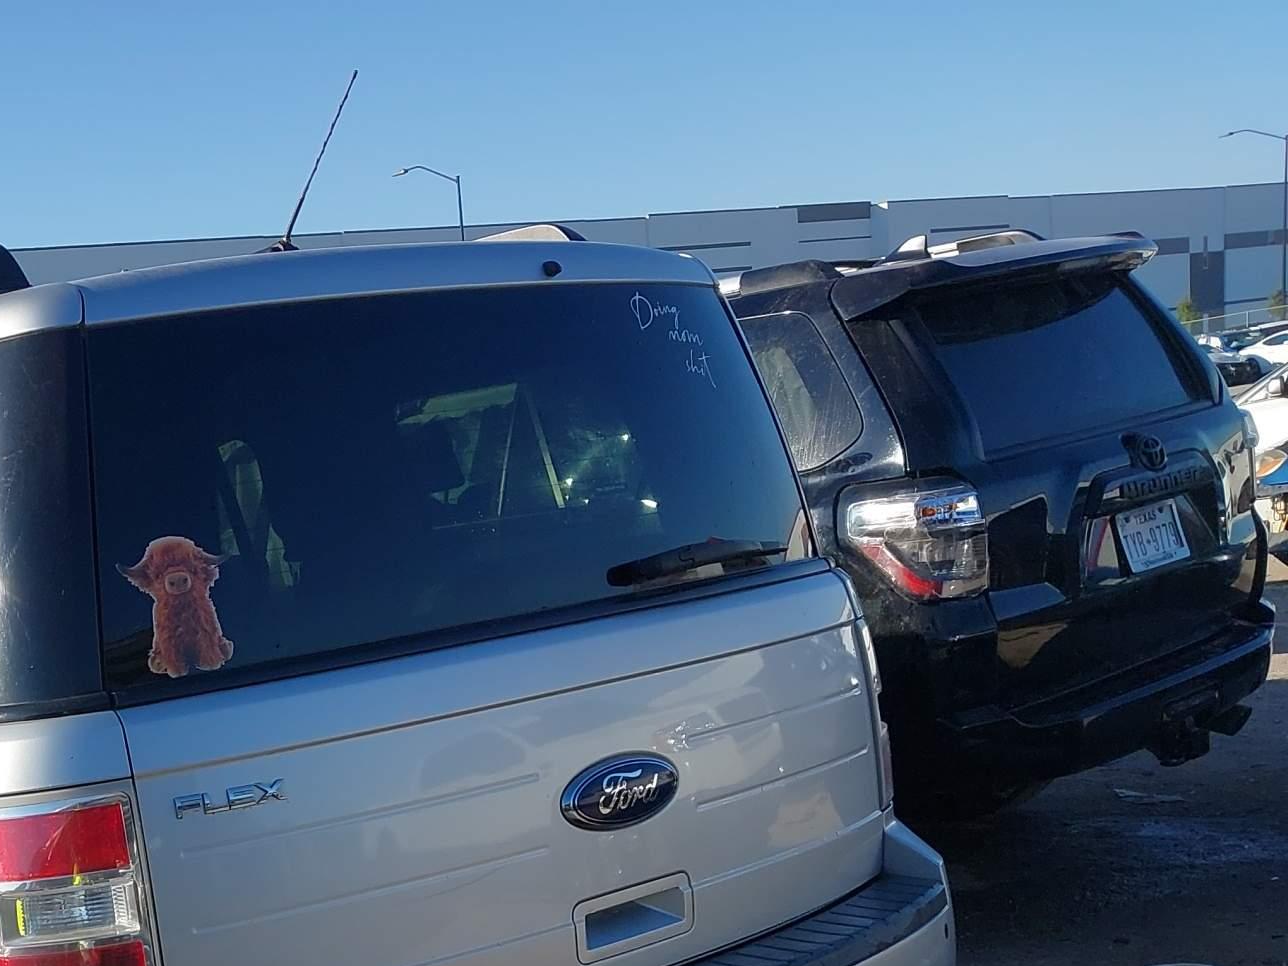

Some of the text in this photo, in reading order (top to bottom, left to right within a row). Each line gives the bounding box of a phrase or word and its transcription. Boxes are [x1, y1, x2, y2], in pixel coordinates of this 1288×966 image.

[1133, 510, 1157, 525] TEXAS
[173, 777, 289, 820] FLEX
[598, 768, 659, 815] Ford
